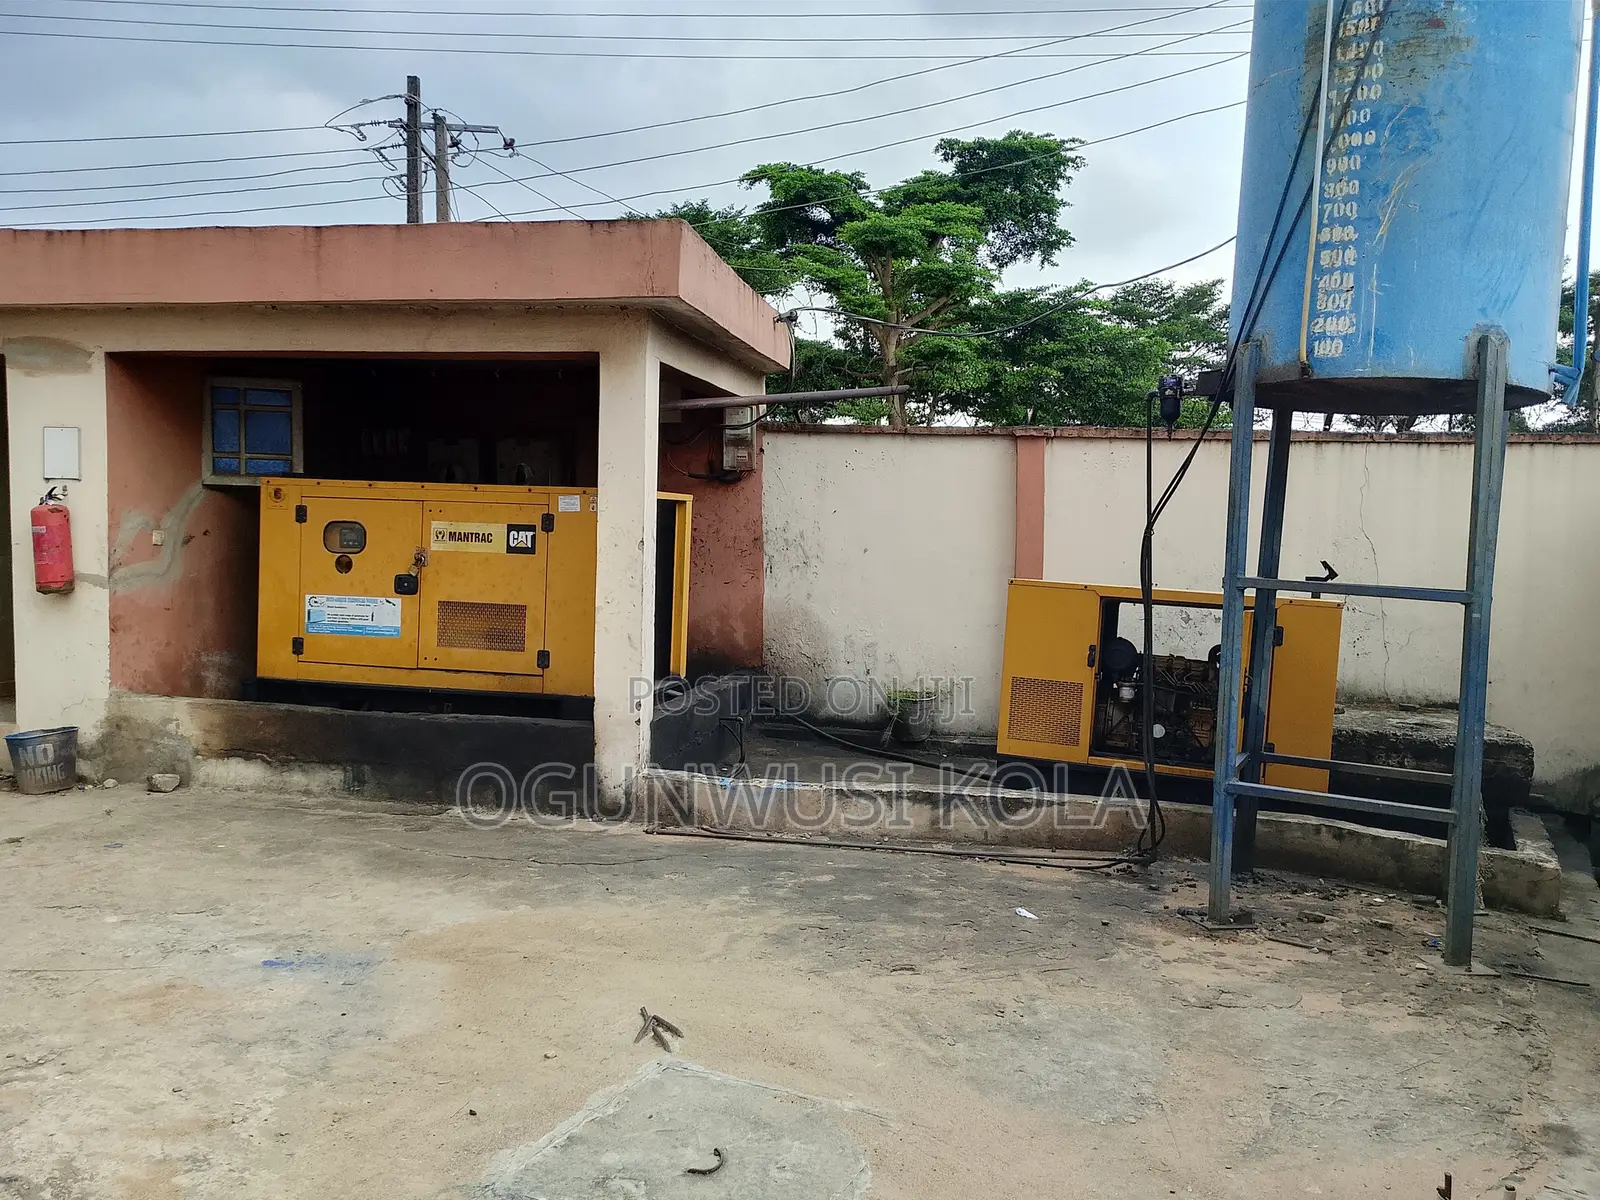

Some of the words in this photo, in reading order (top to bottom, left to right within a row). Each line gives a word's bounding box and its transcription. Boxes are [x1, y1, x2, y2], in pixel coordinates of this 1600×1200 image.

[1326, 154, 1361, 176] 900
[1322, 201, 1359, 223] 700
[1313, 338, 1344, 358] 100
[448, 531, 493, 544] MANTRAC
[509, 530, 536, 548] CAT
[18, 744, 54, 767] NO
